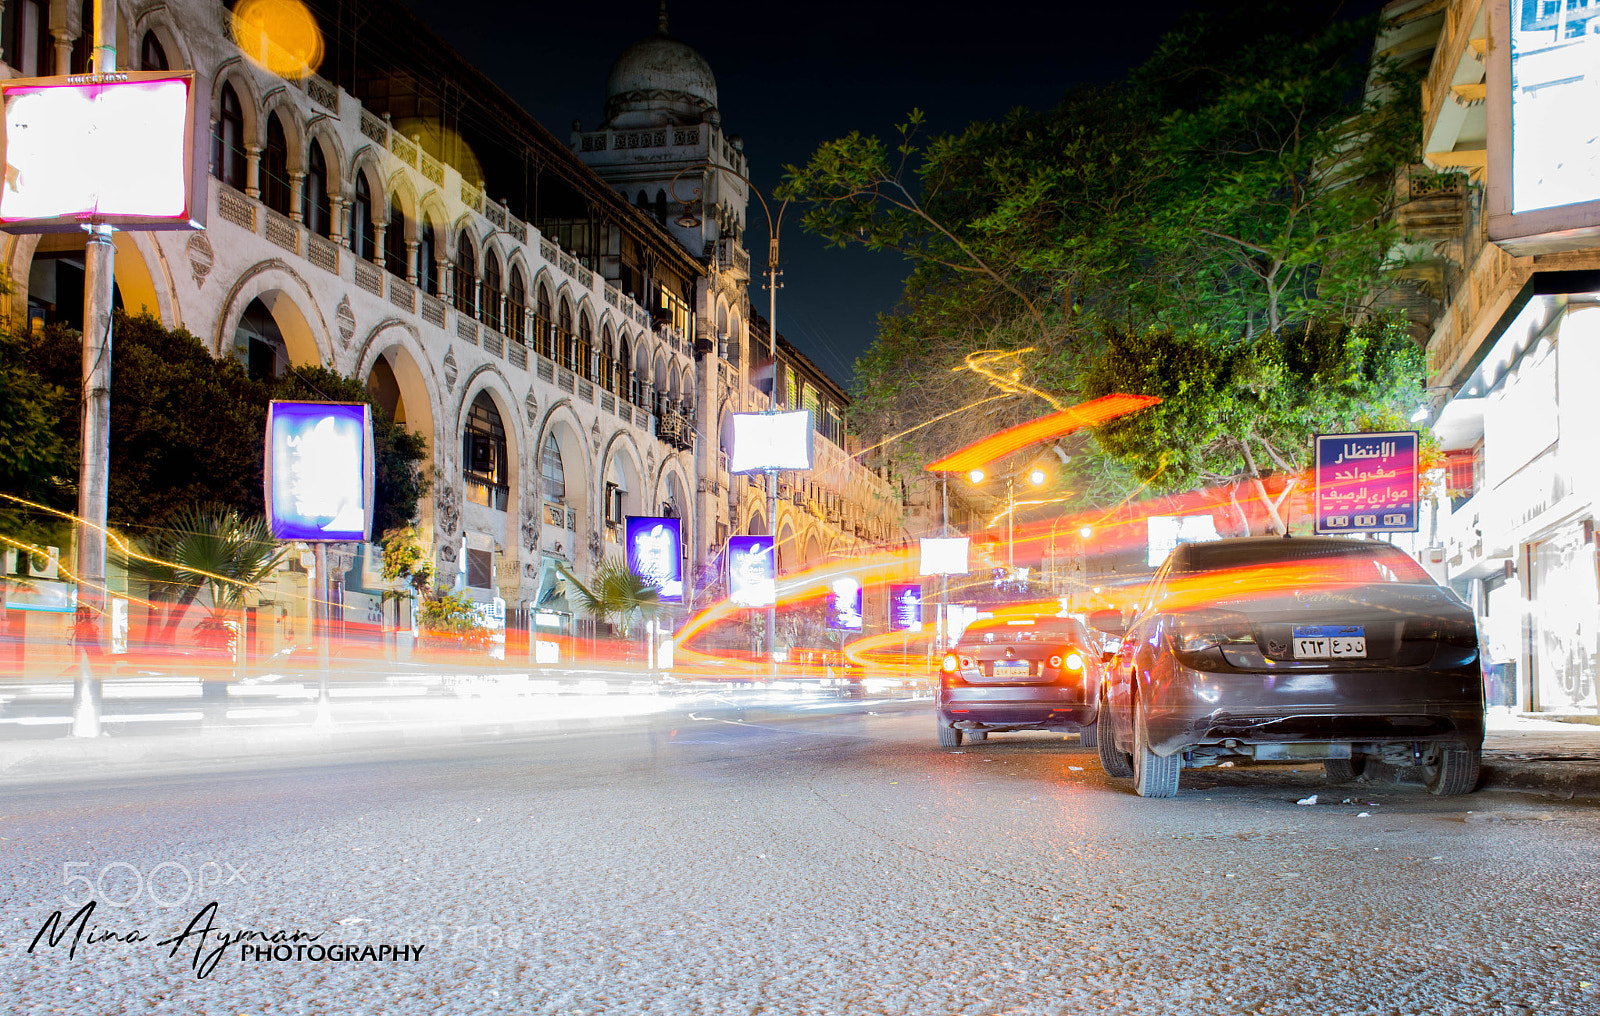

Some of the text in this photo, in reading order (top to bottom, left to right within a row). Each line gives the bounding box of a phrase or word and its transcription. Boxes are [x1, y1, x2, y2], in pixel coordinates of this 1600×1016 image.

[1334, 441, 1396, 464] الإنتظار
[1334, 465, 1396, 482] صف واحد
[1321, 486, 1367, 503] للرصيف
